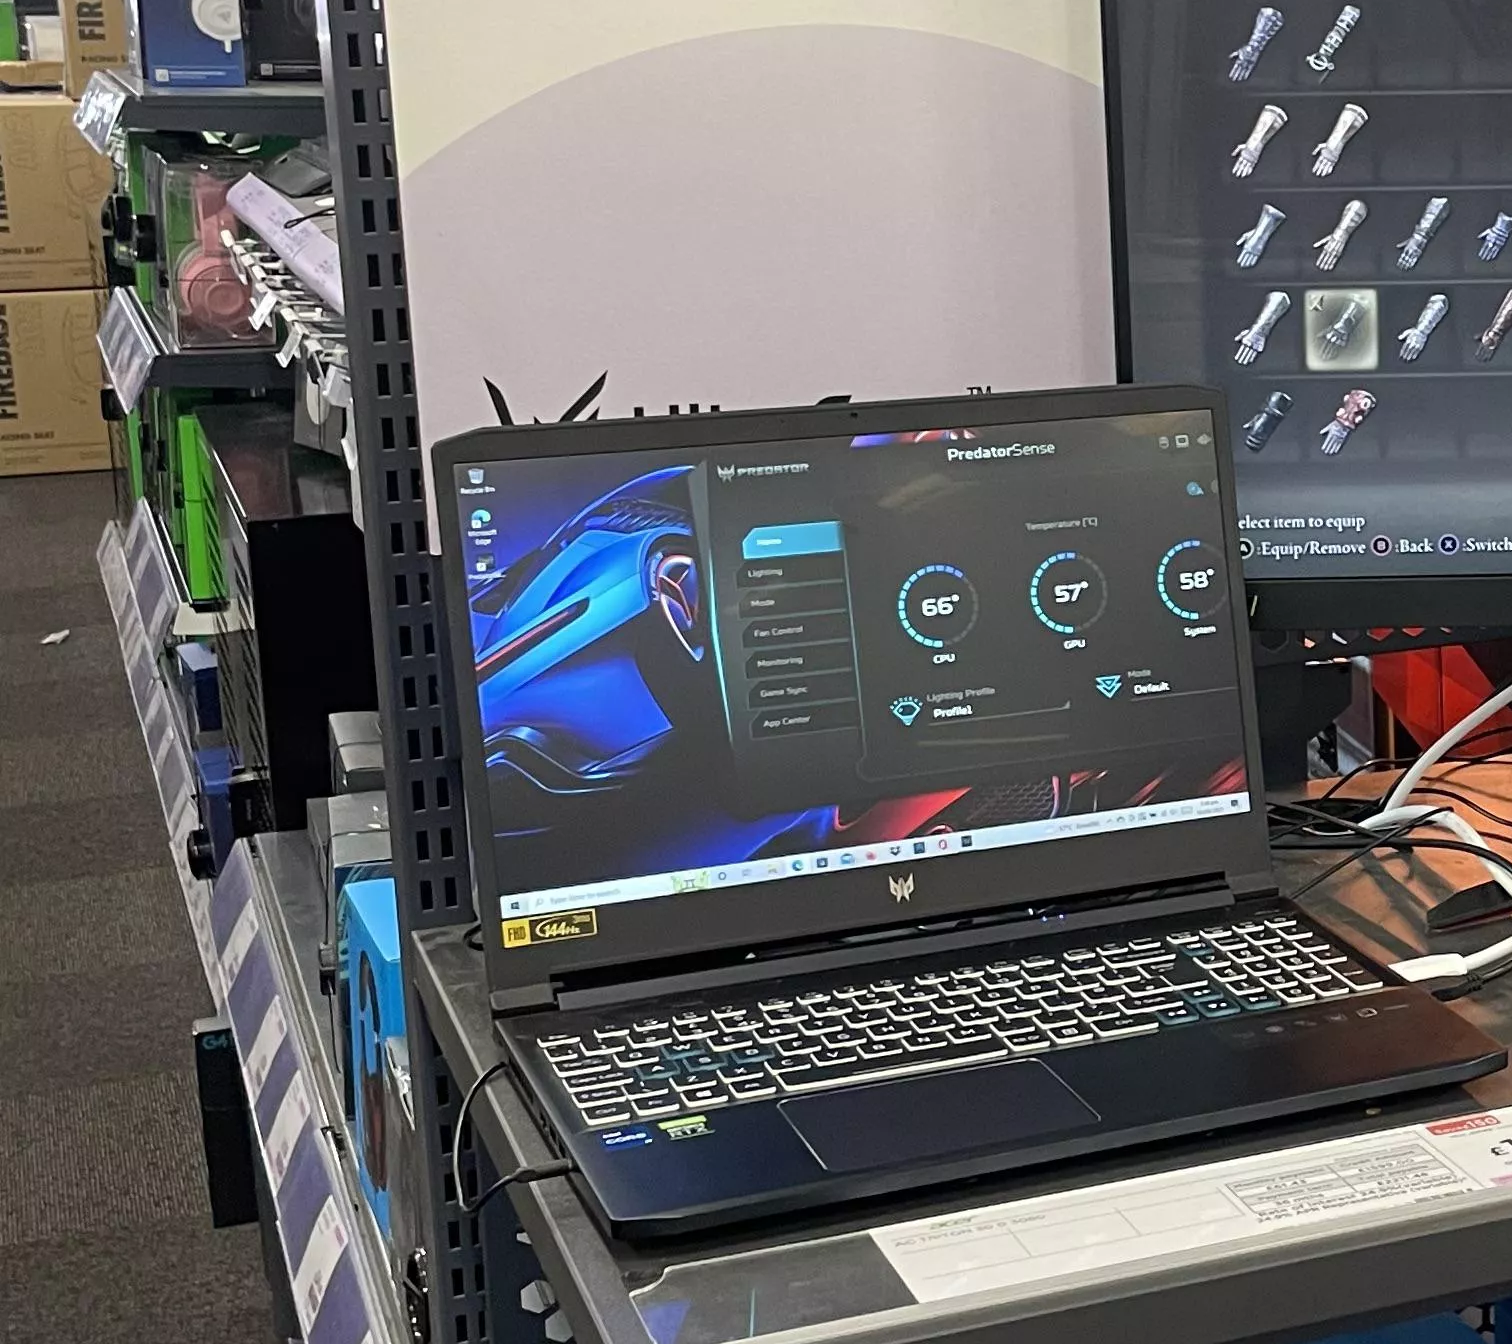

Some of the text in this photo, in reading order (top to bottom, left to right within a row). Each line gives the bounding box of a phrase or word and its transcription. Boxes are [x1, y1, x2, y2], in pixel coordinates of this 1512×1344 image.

[947, 442, 1056, 462] PredatorSense
[1238, 516, 1366, 532] elect item to equip
